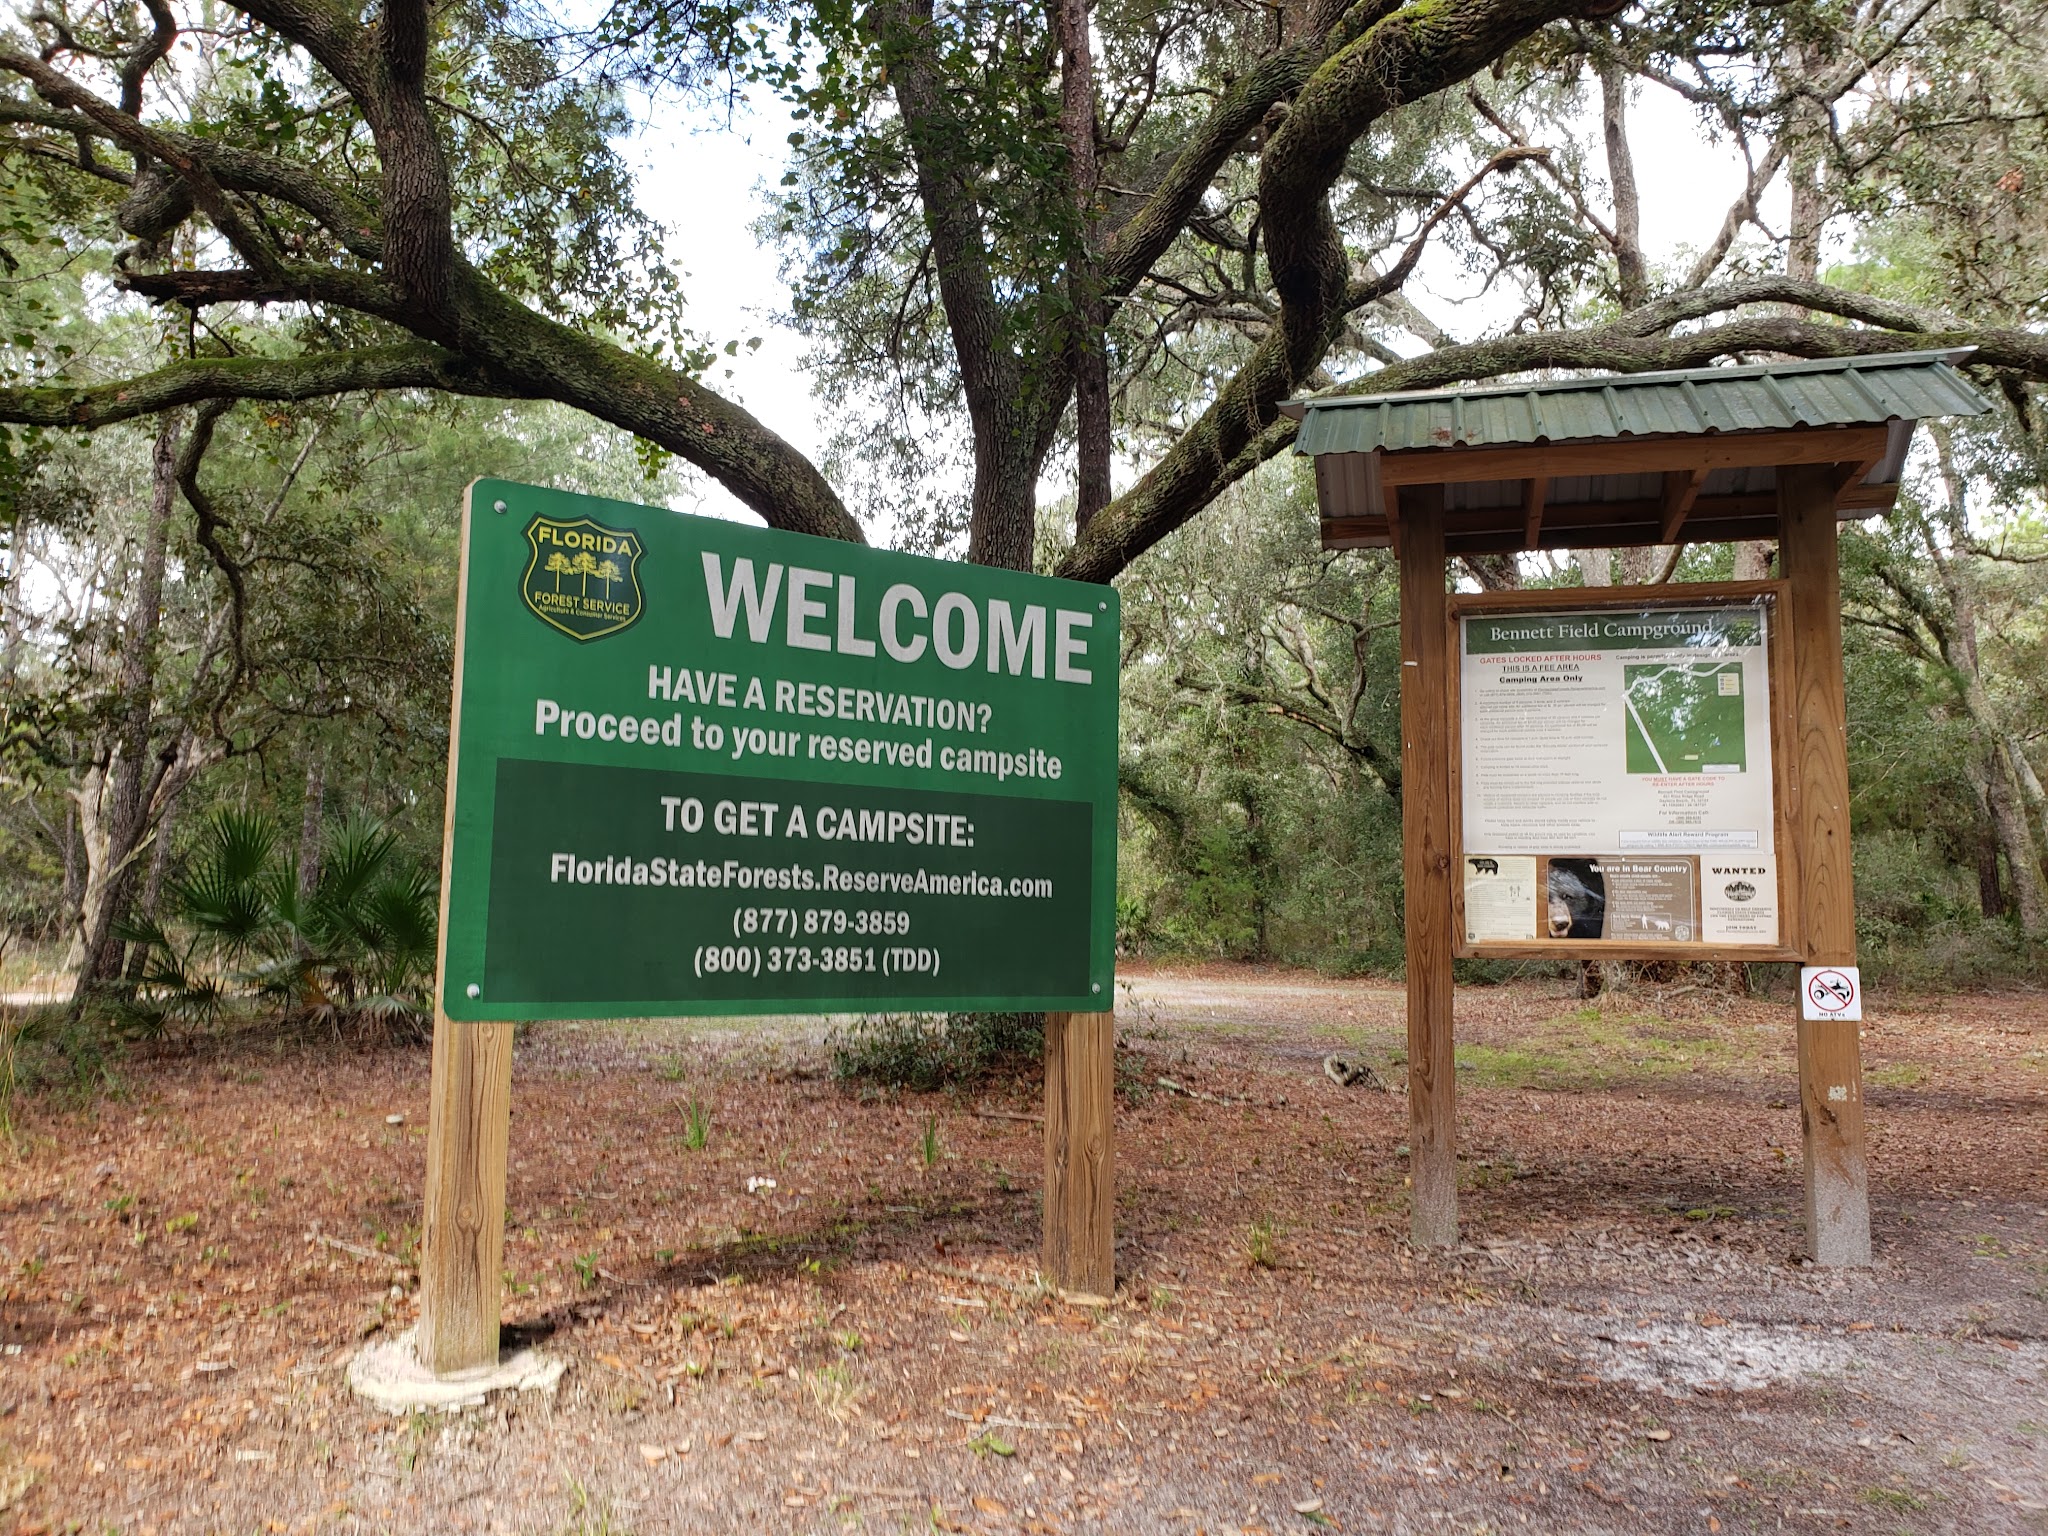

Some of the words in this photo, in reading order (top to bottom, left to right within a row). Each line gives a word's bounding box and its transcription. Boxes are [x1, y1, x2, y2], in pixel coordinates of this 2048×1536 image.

[538, 526, 632, 557] FLORIDA
[535, 591, 580, 608] FOREST
[583, 598, 630, 615] SERVICE
[539, 604, 570, 615] Agriculture
[570, 607, 575, 615] &
[576, 608, 603, 619] Consumer
[604, 612, 626, 622] Services
[701, 551, 1093, 685] WELCOME
[1490, 626, 1554, 641] Bennett
[1559, 622, 1599, 639] Field
[1604, 618, 1713, 640] Campground
[1480, 657, 1506, 665] GATES
[1509, 655, 1542, 663] LOCKED
[1572, 653, 1602, 661] HOURS
[1502, 665, 1520, 673] THIS
[1522, 665, 1530, 673] IS
[1540, 664, 1555, 672] FEE
[1556, 664, 1580, 672] AREA
[1500, 676, 1537, 684] Camping
[1563, 674, 1583, 683] Only
[648, 664, 738, 708] HAVE
[743, 676, 767, 711] A
[775, 680, 992, 734] RESERVATION?
[535, 698, 682, 748] Proceed
[691, 715, 724, 751] to
[731, 726, 801, 760] your
[808, 733, 933, 769] reserved
[940, 746, 1062, 781] campsite
[660, 796, 704, 834] TO
[714, 800, 779, 837] GET
[785, 804, 809, 839] A
[816, 806, 975, 848] CAMPSITE:
[551, 853, 1053, 898] FloridaStateForests.ReserveAmerica.com
[1589, 864, 1605, 873] You
[1606, 865, 1620, 873] are
[1622, 864, 1631, 873] in
[1632, 864, 1652, 873] Bear
[1653, 864, 1688, 874] Country
[1712, 867, 1766, 875] WANTED
[733, 907, 798, 939] (877)
[804, 909, 910, 935] 879-3859
[694, 946, 761, 978] (800)
[767, 946, 876, 972] 373-3851
[883, 948, 940, 977] (TDD)
